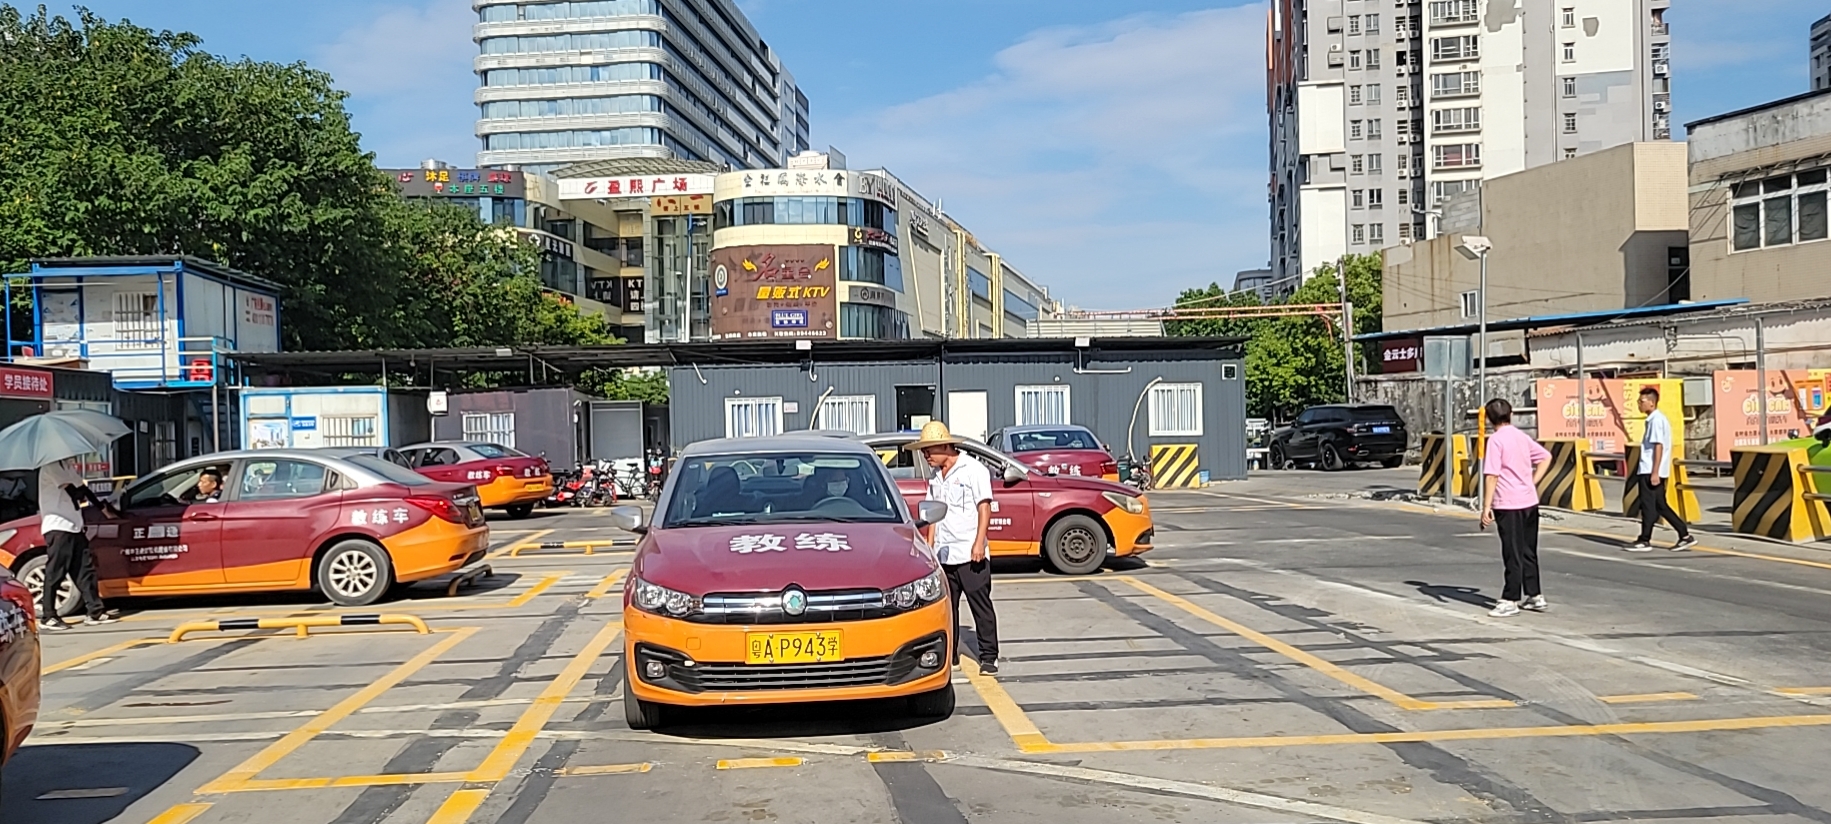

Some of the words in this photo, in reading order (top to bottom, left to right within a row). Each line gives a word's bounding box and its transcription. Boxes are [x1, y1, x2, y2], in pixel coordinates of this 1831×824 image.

[425, 170, 450, 182] 沐足
[607, 177, 687, 194] 盈熙广场
[1383, 346, 1423, 361] 金云士多
[4, 374, 48, 392] 学员接待处
[351, 508, 409, 525] 教练车
[729, 532, 852, 554] 教练
